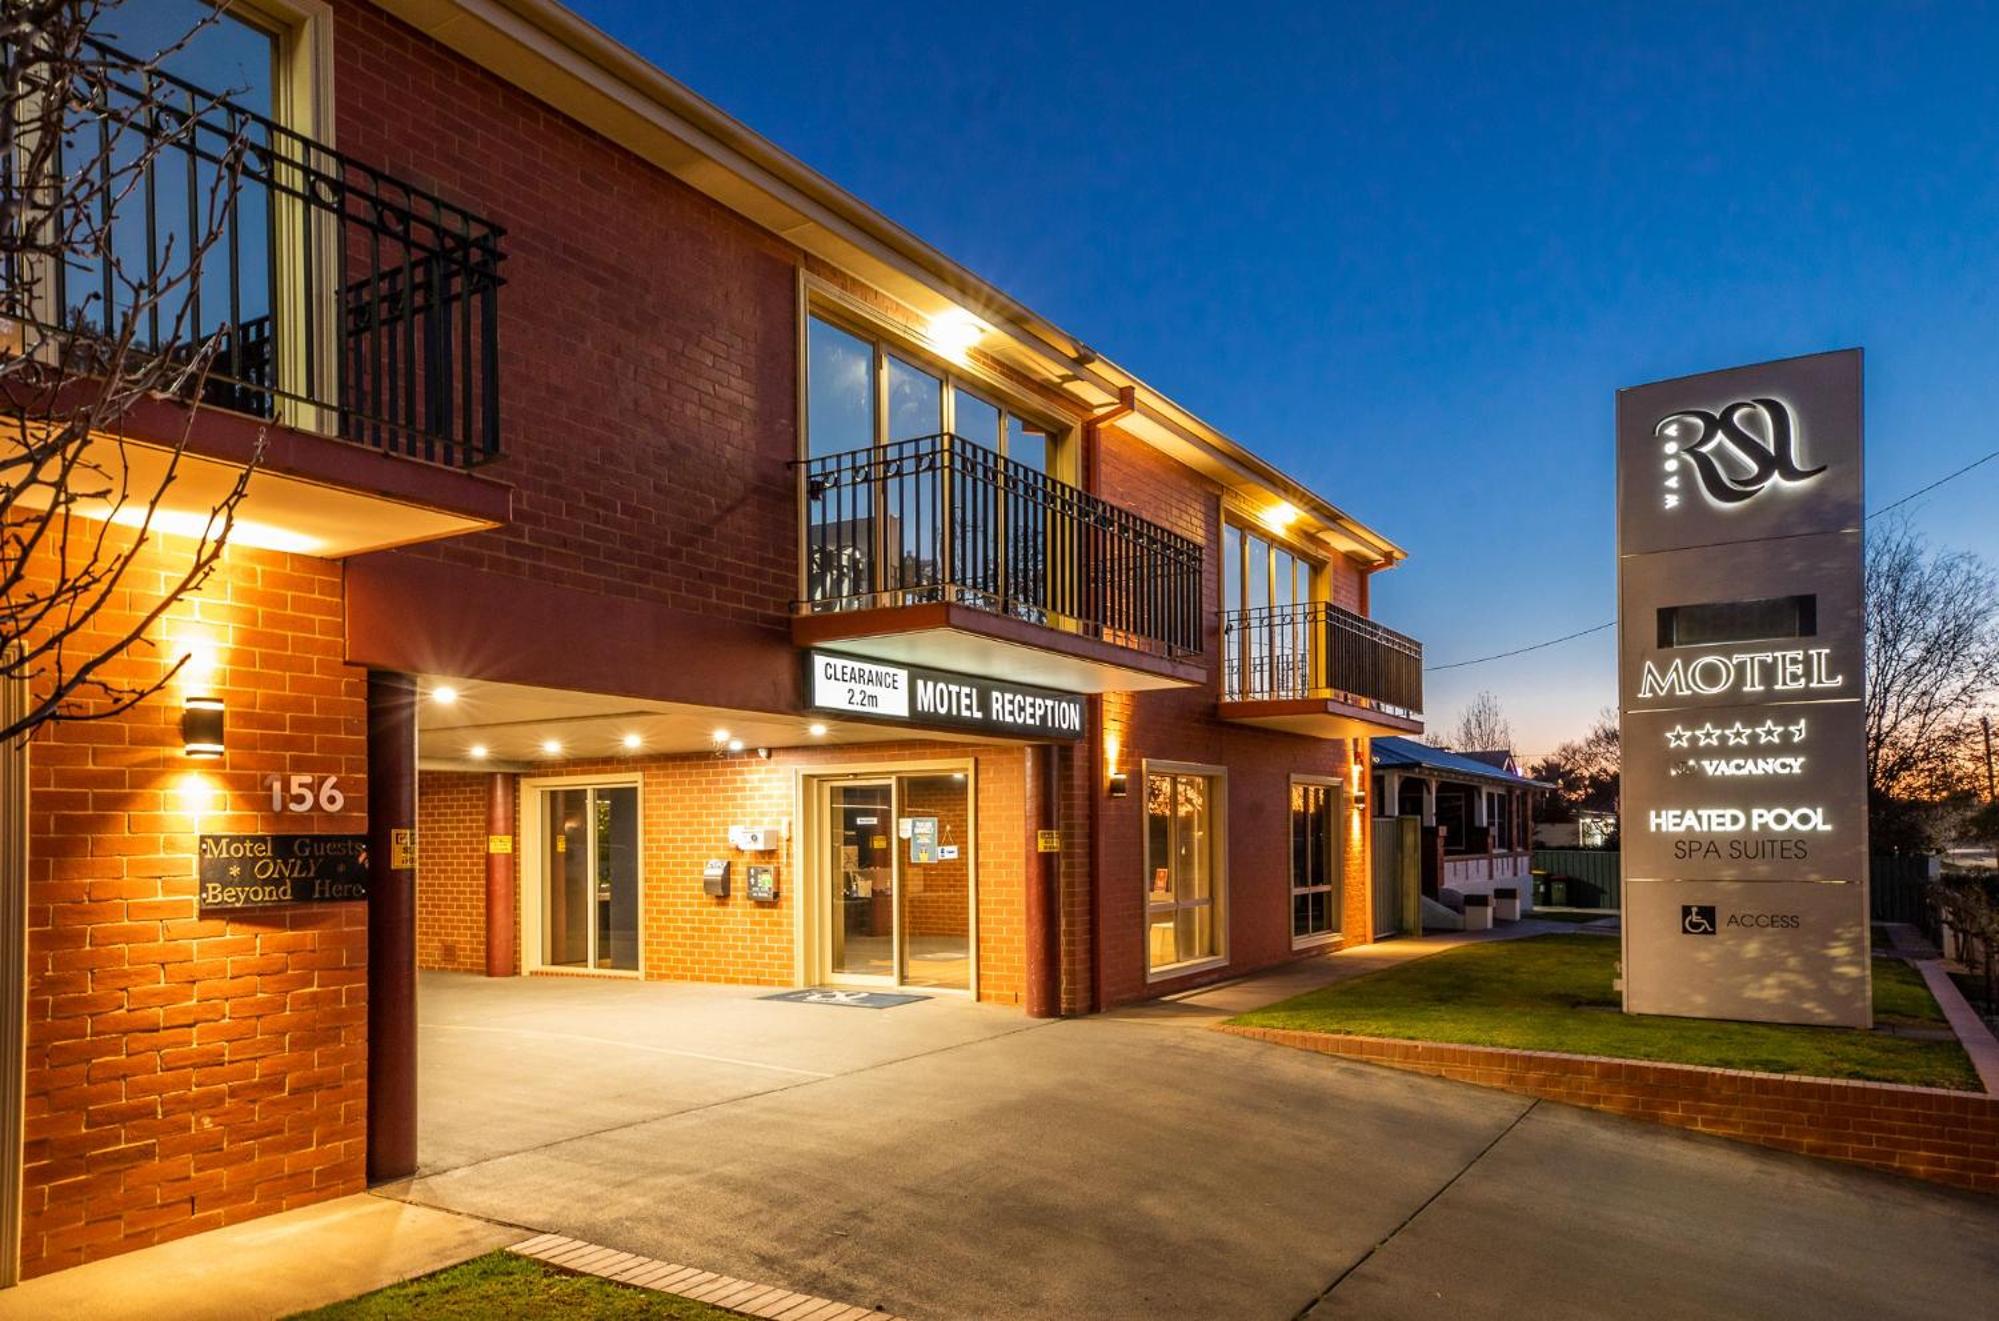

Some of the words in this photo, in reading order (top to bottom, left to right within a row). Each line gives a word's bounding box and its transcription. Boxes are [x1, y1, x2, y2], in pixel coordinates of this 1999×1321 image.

[1653, 398, 1828, 504] RSL
[823, 661, 900, 690] CLEARANCE
[1637, 649, 1843, 699] MOTEL
[847, 688, 878, 708] 2.2m
[916, 678, 983, 719] MOTEL
[991, 690, 1081, 731] RECEPTION
[1701, 757, 1805, 776] VACANCY
[264, 774, 345, 813] 156
[1650, 809, 1746, 833] HEATED
[1751, 808, 1833, 832] POOL
[205, 837, 272, 859] Motel
[294, 837, 363, 856] Guests
[1674, 840, 1721, 860] SPA
[1729, 839, 1808, 860] SUITES
[254, 858, 321, 880] ONLY
[205, 880, 292, 907] Beyond
[313, 879, 362, 899] Here
[1726, 913, 1800, 930] ACCESS
